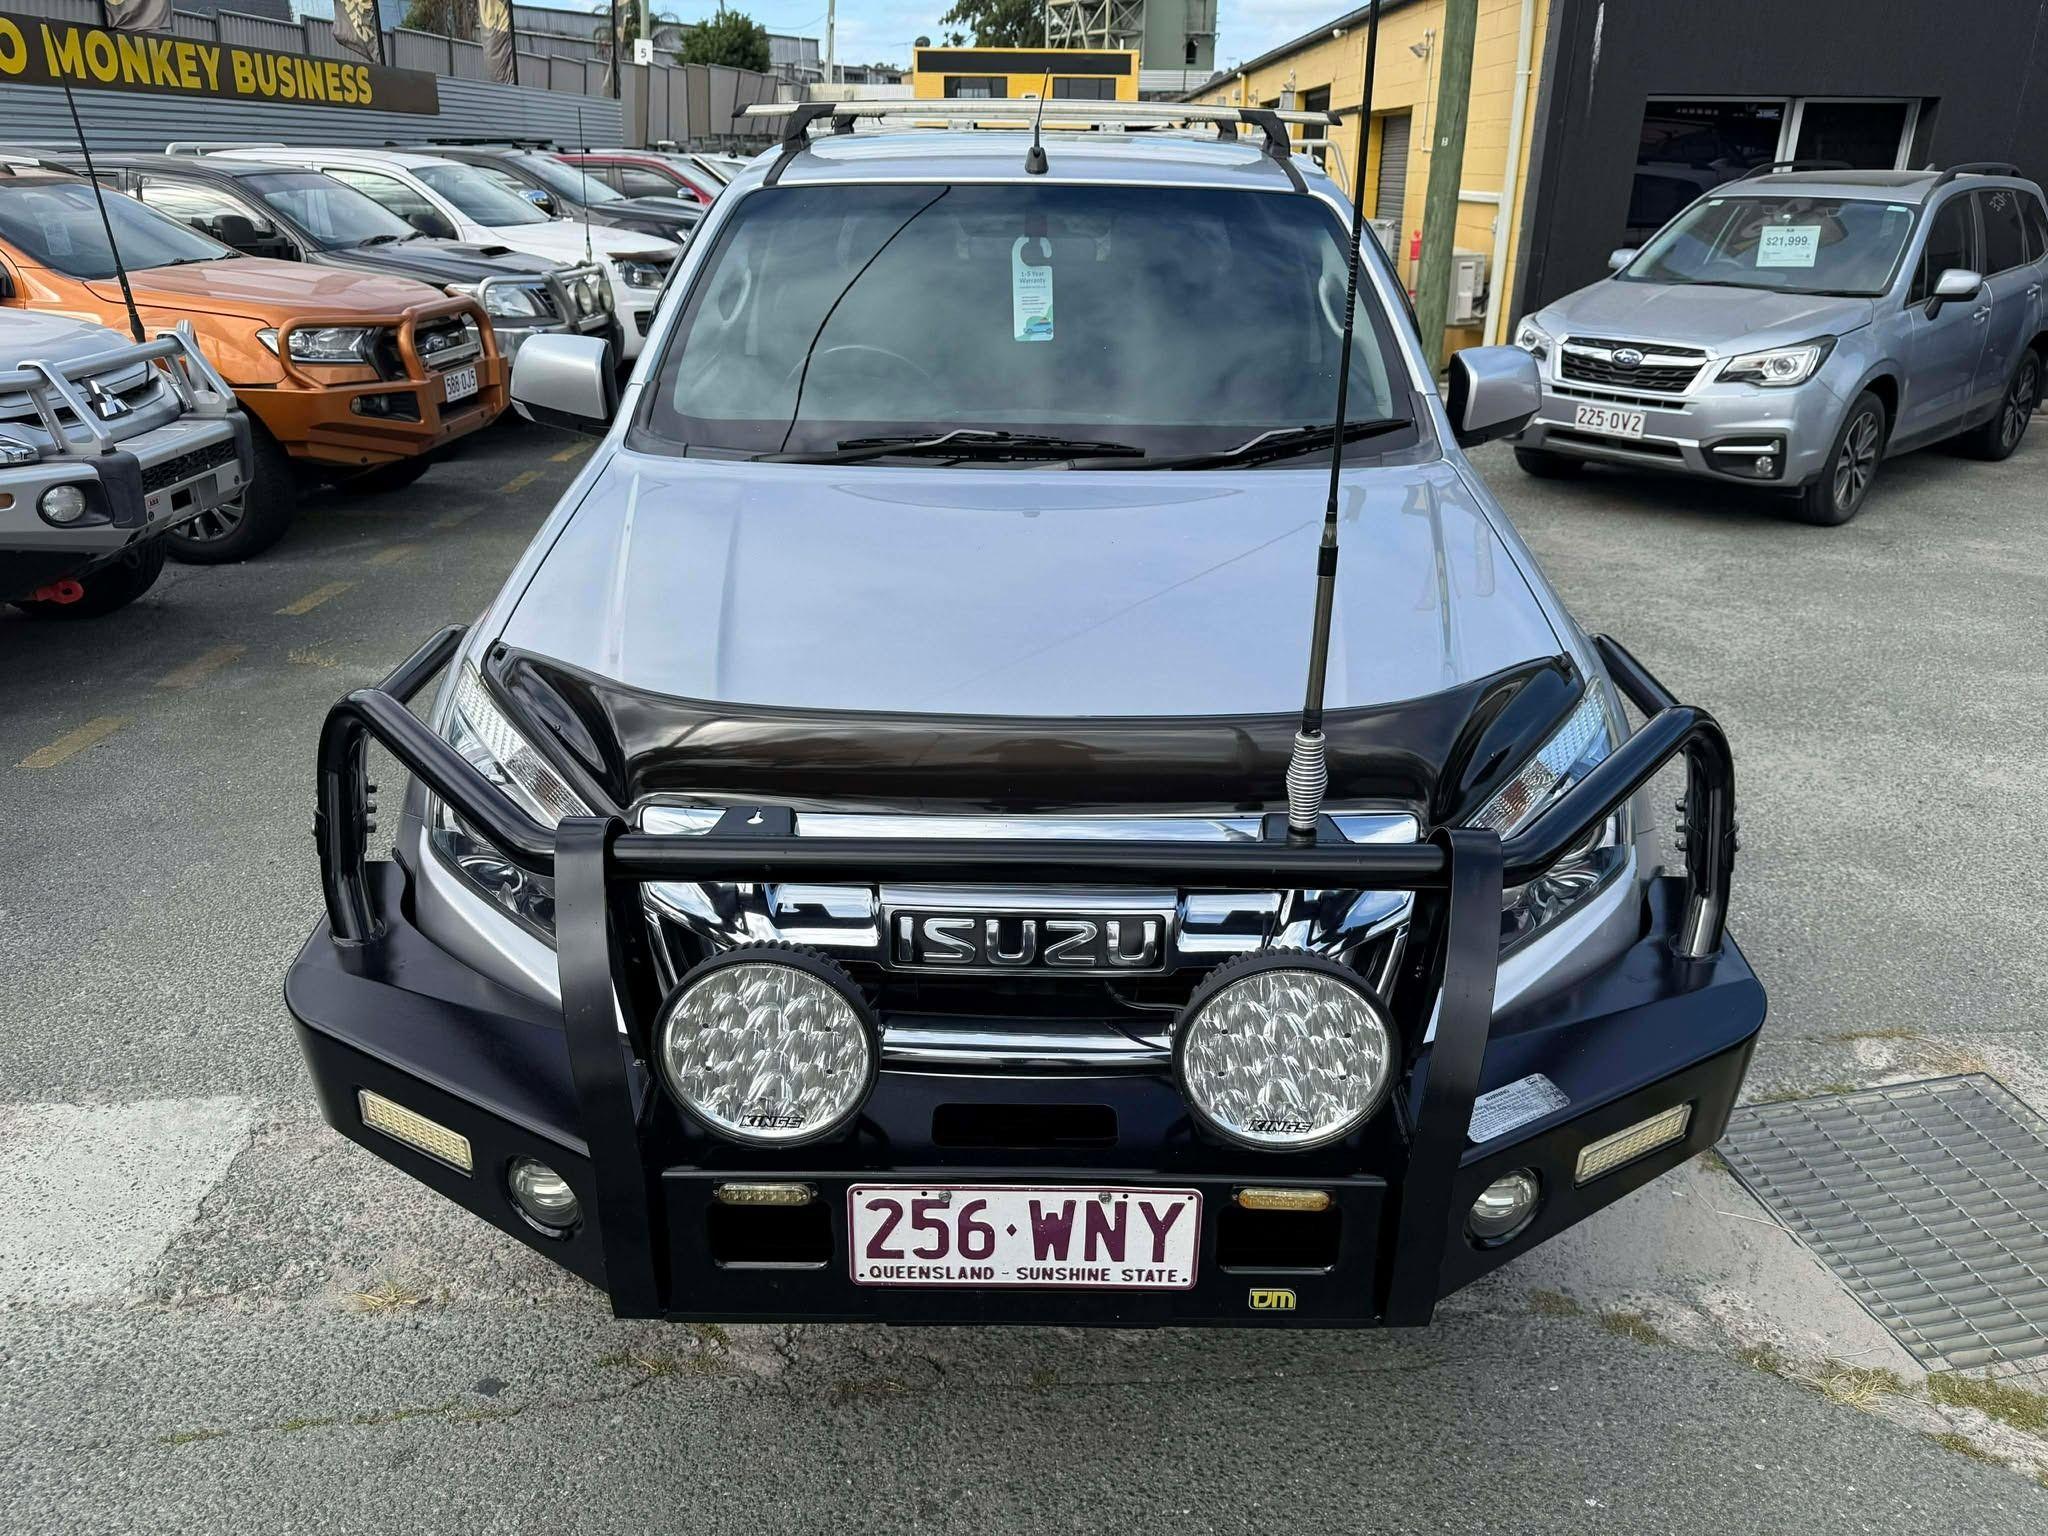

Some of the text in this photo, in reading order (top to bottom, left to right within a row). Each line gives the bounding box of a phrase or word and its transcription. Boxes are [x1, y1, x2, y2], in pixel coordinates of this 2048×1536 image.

[640, 47, 647, 58] 5
[41, 24, 221, 92] MONKEY
[232, 51, 373, 105] BUSINESS
[1766, 235, 1808, 247] $21,999
[1019, 278, 1046, 286] Warranty
[899, 916, 1157, 966] ISUZU
[739, 1115, 804, 1128] KINGS
[1242, 1119, 1313, 1133] KINGS
[869, 1265, 995, 1281] QUEENSLAND
[1016, 1266, 1111, 1282] SUNSHINE
[1122, 1267, 1178, 1283] STATE
[1251, 1291, 1294, 1308] TJM
